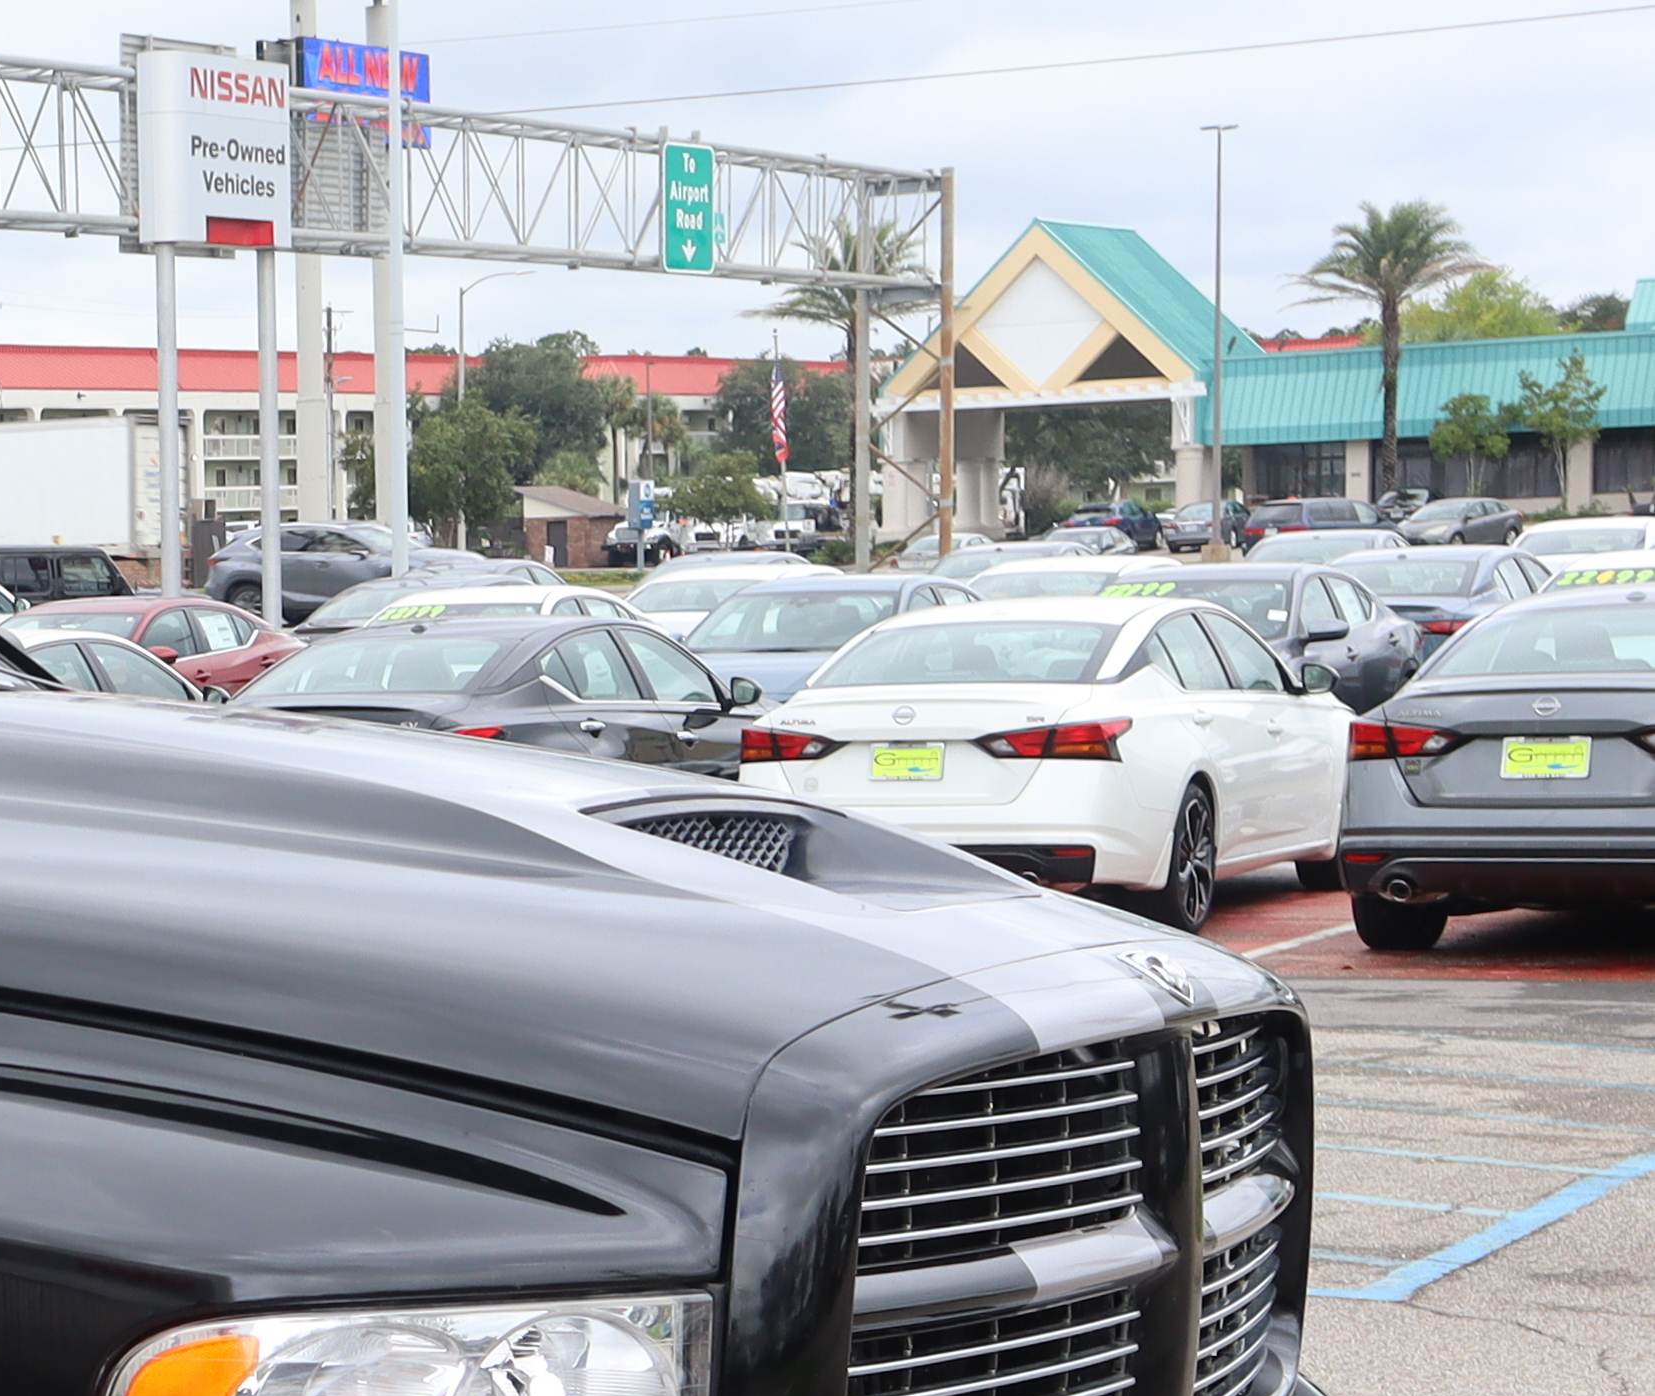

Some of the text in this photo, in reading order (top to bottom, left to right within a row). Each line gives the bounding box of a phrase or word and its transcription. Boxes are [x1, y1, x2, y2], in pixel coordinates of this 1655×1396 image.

[318, 45, 360, 86] ALL
[190, 67, 284, 108] NISSAN
[191, 135, 285, 165] Pre-Owned
[682, 152, 696, 173] To
[202, 170, 275, 198] Vehicles
[670, 180, 709, 205] Airport
[675, 208, 703, 230] Road
